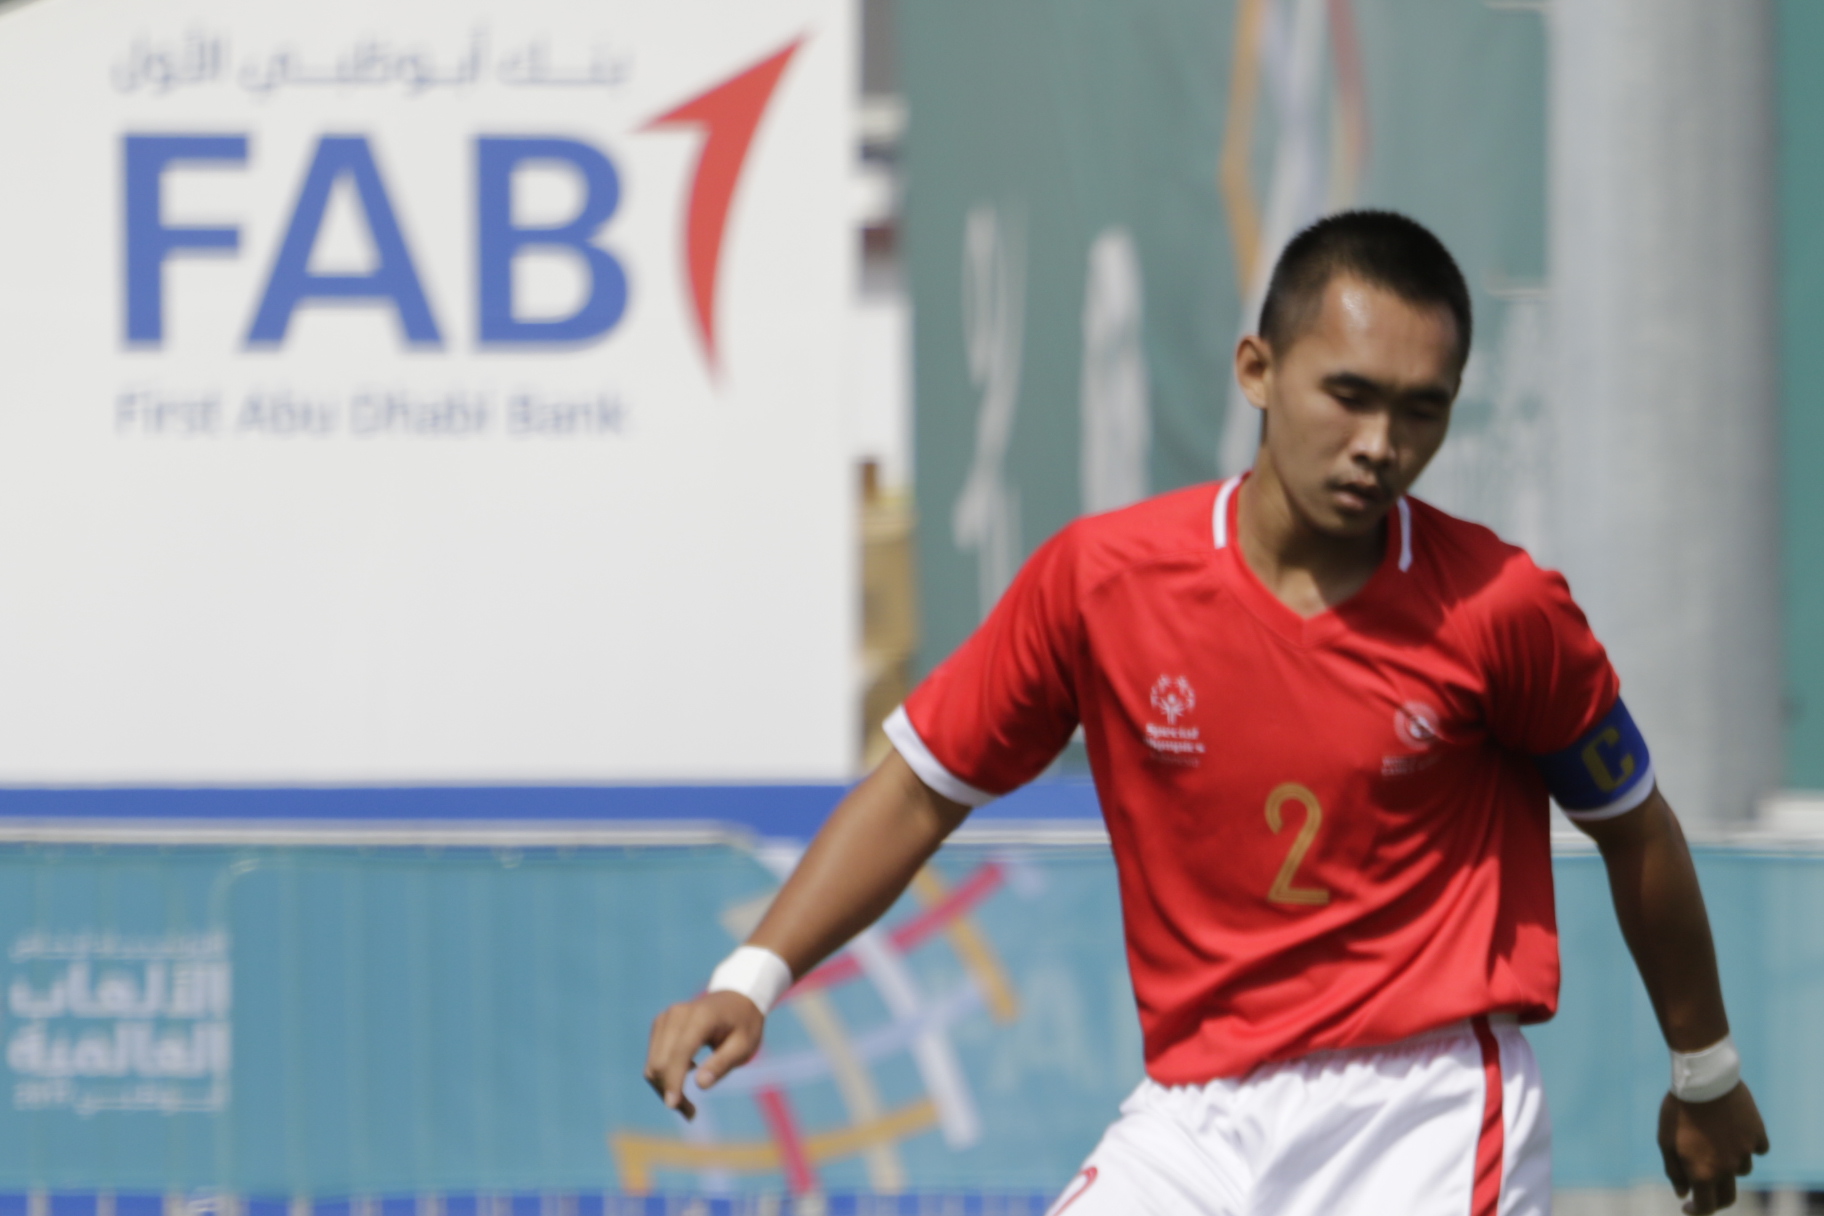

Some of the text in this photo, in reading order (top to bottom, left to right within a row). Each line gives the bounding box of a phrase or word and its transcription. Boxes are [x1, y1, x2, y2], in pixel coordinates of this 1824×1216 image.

[498, 30, 636, 98] بنك
[120, 131, 630, 352] FAB
[114, 389, 628, 437] First Abu Dhabi Bank
[1146, 723, 1199, 740] Special
[1581, 725, 1635, 795] C
[1265, 782, 1330, 906] 2
